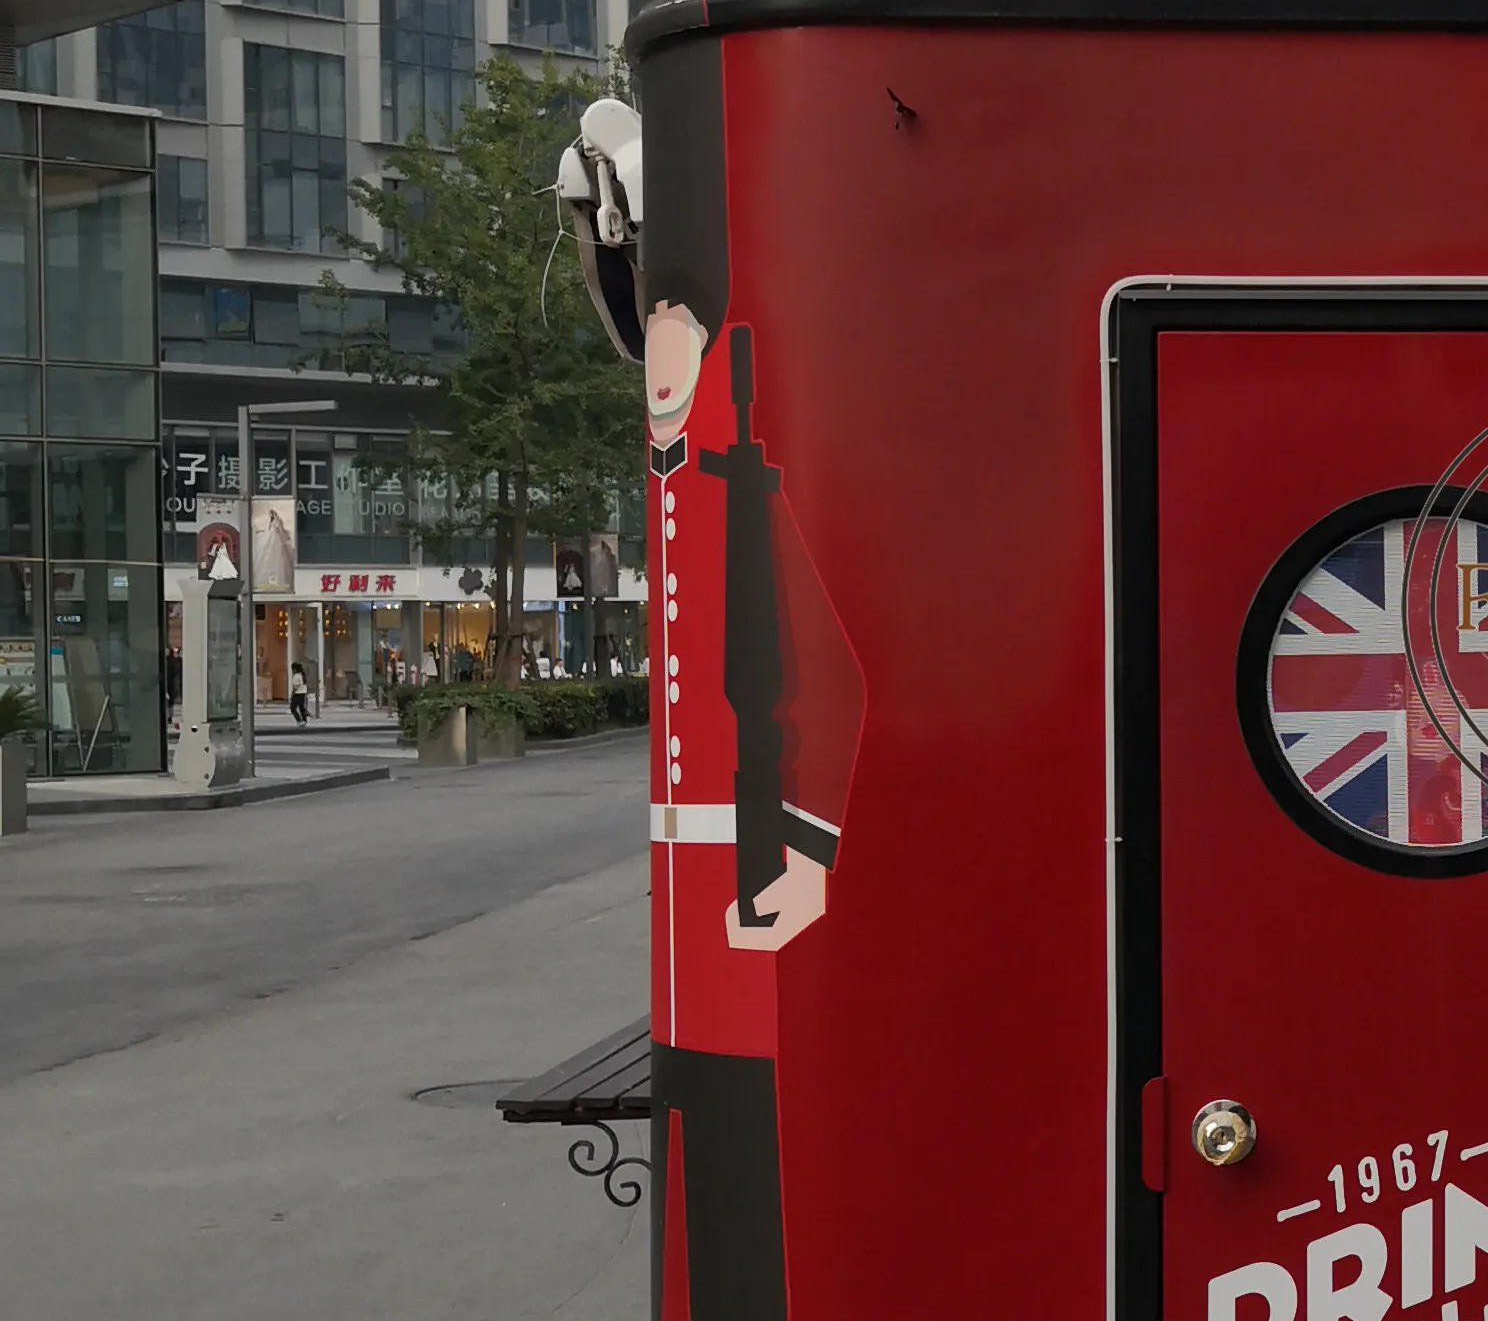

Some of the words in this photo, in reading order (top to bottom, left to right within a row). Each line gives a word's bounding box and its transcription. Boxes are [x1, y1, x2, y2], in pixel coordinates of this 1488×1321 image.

[321, 574, 397, 593] 好利来
[1326, 1129, 1450, 1213] 1967
